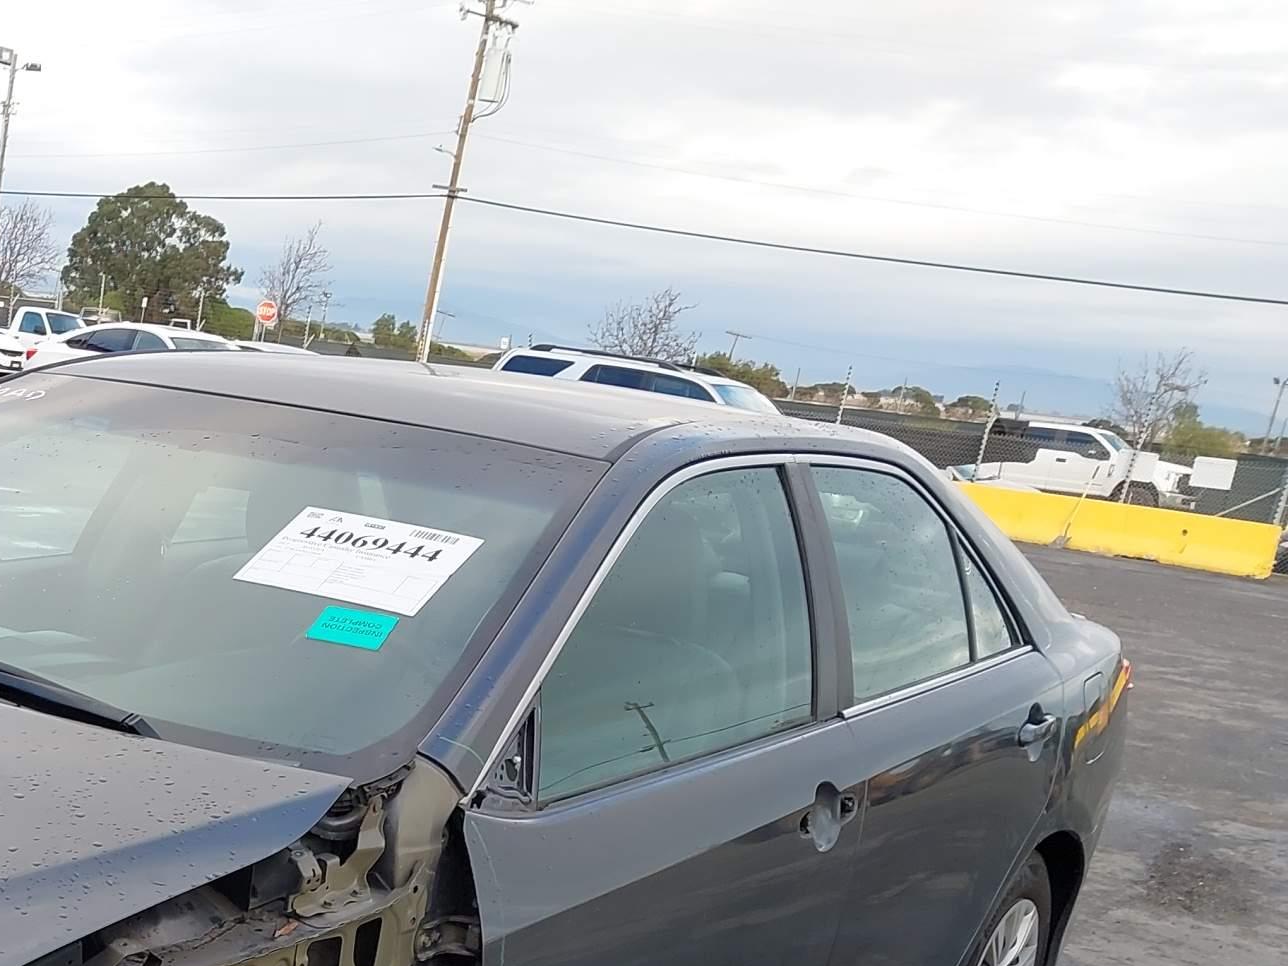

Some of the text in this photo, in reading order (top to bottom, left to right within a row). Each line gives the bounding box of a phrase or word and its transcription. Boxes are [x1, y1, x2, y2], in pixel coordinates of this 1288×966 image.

[300, 526, 443, 562] 44069444
[321, 622, 383, 638] INSPECTION
[328, 615, 383, 630] COMPLETE
